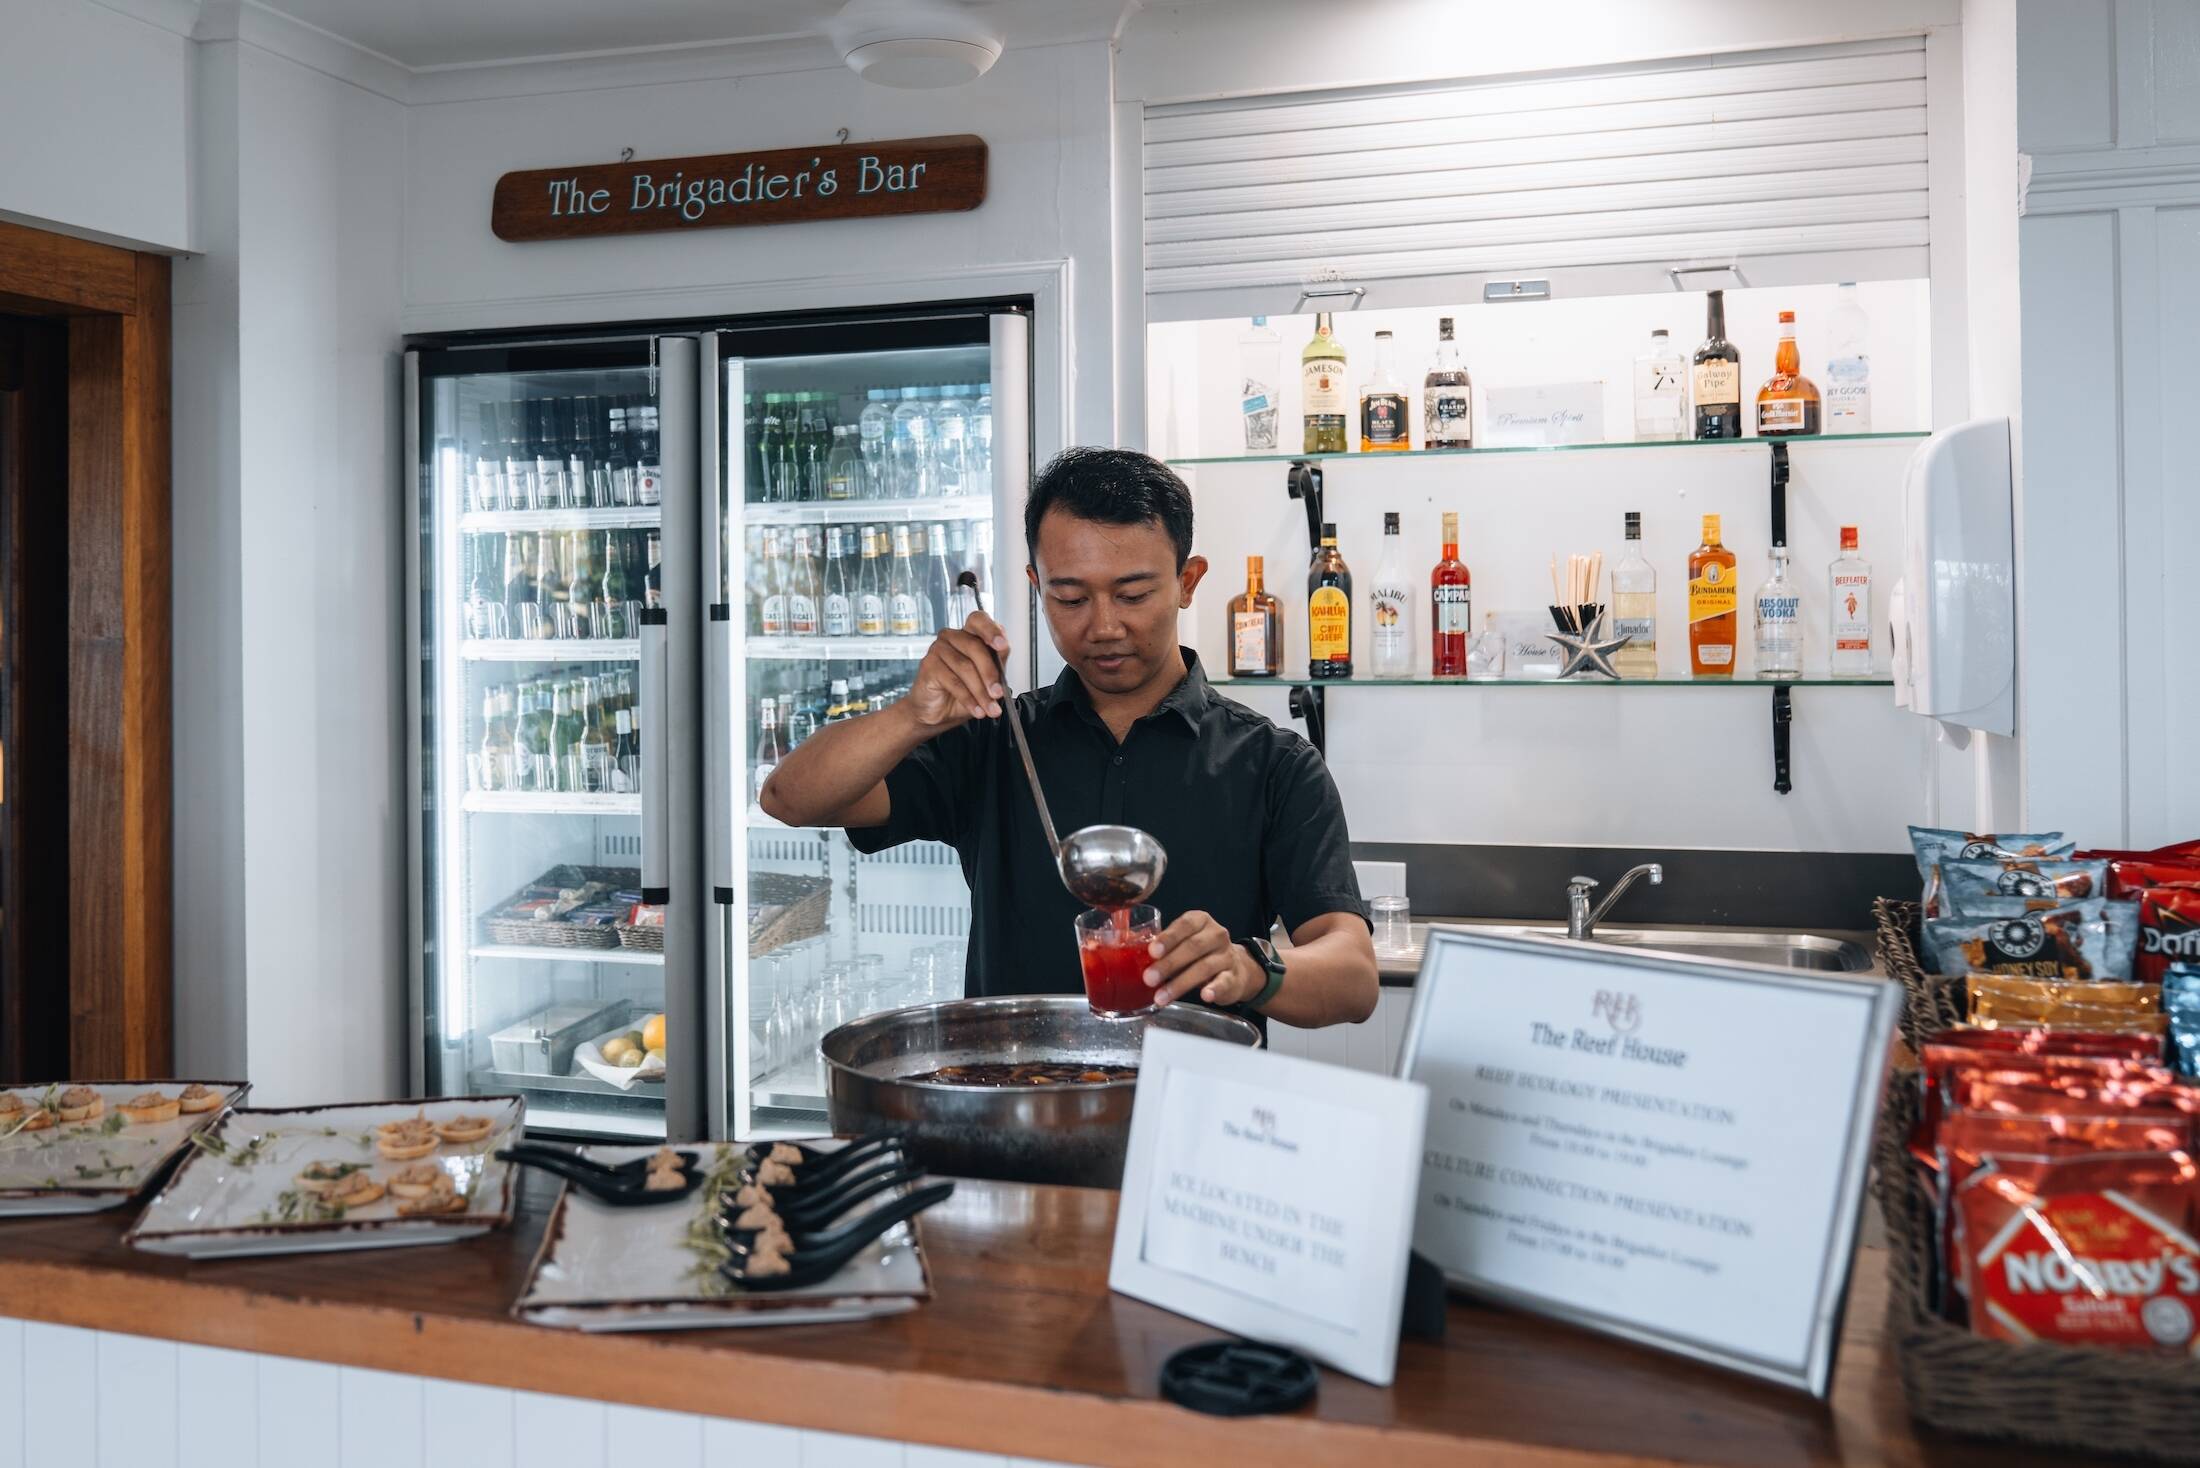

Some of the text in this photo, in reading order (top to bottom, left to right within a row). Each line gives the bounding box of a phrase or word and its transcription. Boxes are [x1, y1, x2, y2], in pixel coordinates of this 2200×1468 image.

[549, 156, 926, 221] The Brigadier's Bar
[1305, 364, 1343, 376] JAMESON
[1758, 598, 1799, 608] ABSOLUT
[1835, 576, 1868, 586] BEEFEATER
[1762, 608, 1795, 618] VODKA
[1530, 1021, 1688, 1070] The Reef House
[1475, 1063, 1736, 1125] REEF ECOLOGY PRESENTATION
[1200, 1179, 1281, 1218] LOCATED
[1308, 1211, 1345, 1238] THE
[1500, 1166, 1611, 1204] CONNECTION
[1613, 1191, 1754, 1238] PRESENTATION
[1163, 1195, 1238, 1234] MACHINE
[1310, 1239, 1347, 1269] THE
